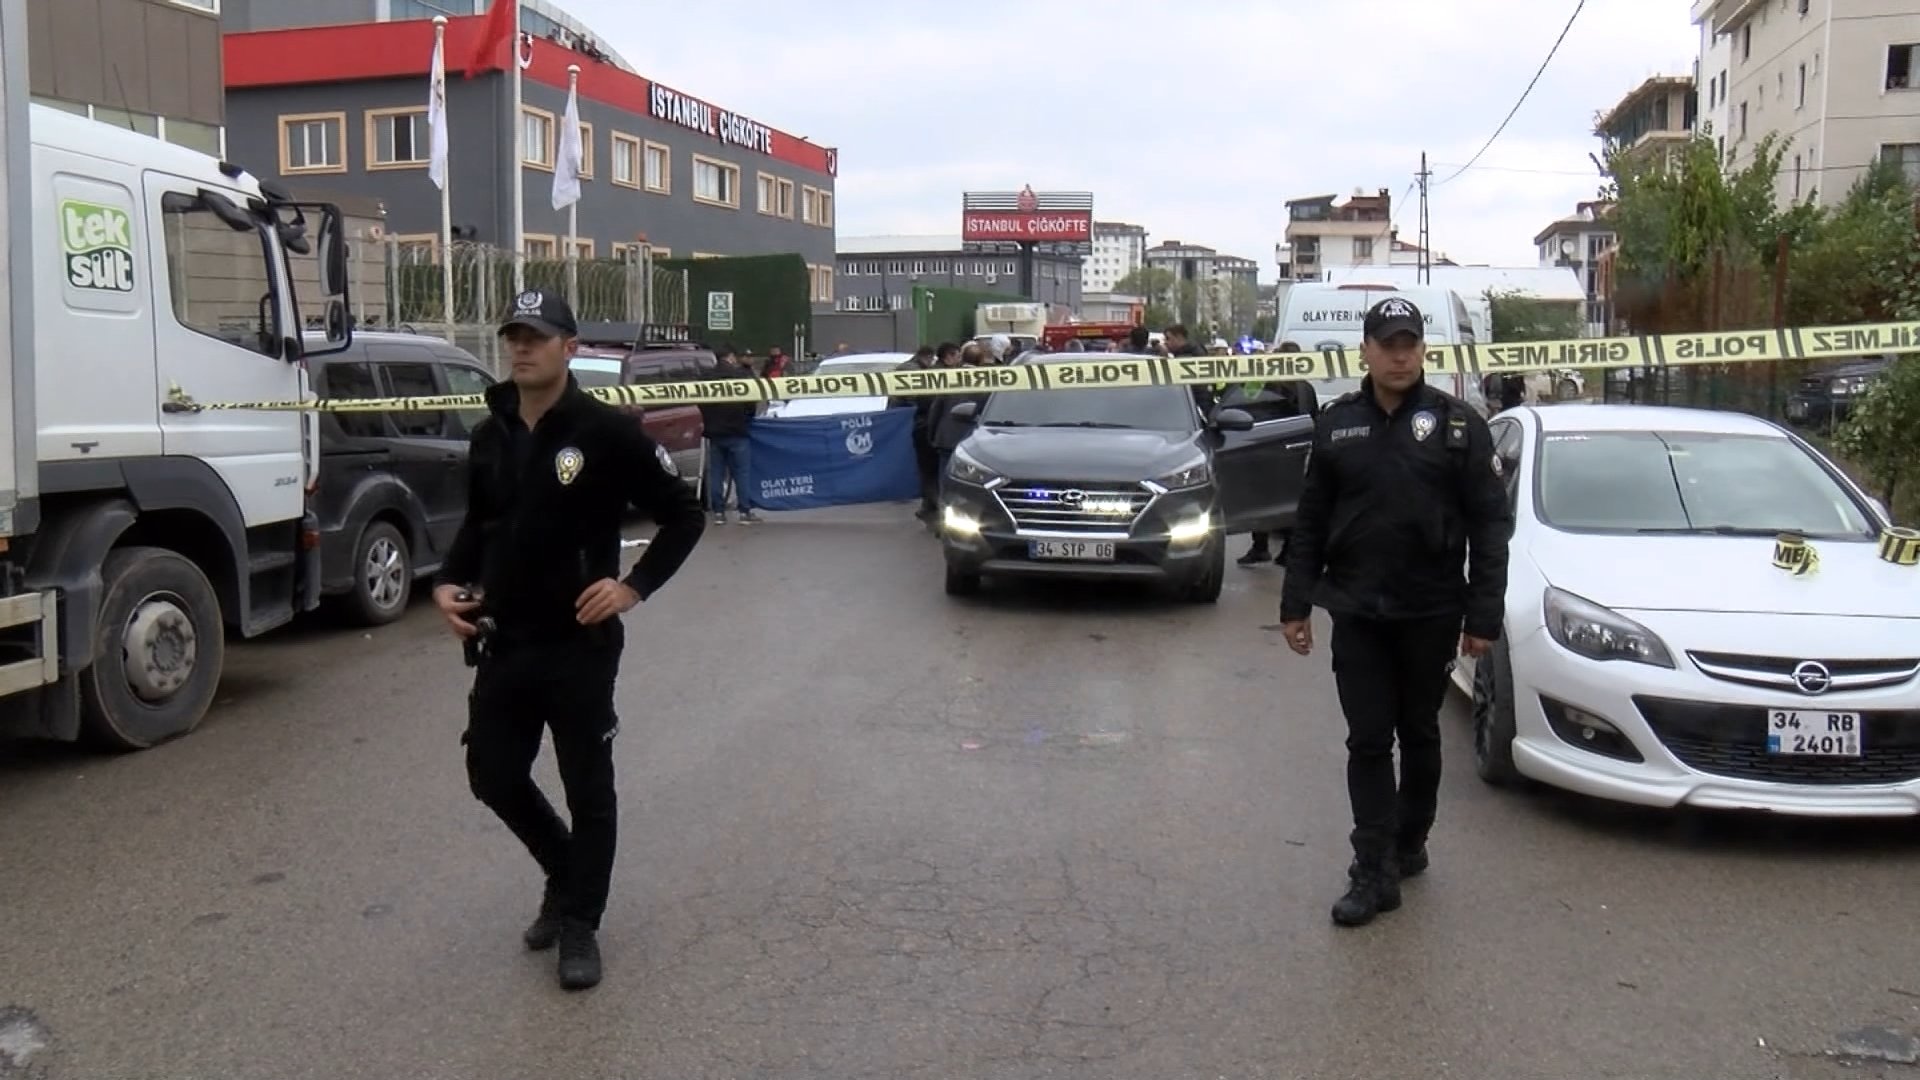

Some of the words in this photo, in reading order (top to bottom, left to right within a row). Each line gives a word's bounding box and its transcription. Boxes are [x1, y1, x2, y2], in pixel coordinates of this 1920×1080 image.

[651, 82, 716, 135] İSTANBUL
[719, 111, 773, 154] ÇİĞKÖFTE
[65, 207, 129, 248] tek
[967, 215, 1023, 232] İSTANBUL
[1027, 216, 1087, 234] ÇİĞKÖFTE
[71, 250, 132, 290] süt
[1303, 311, 1328, 321] OLAY
[761, 478, 786, 489] OLAY
[1038, 542, 1053, 556] 34
[1062, 543, 1086, 556] STP
[1095, 543, 1112, 557] 06
[1774, 712, 1801, 729] 34
[1827, 714, 1854, 732] RB
[1793, 735, 1844, 753] 2401
